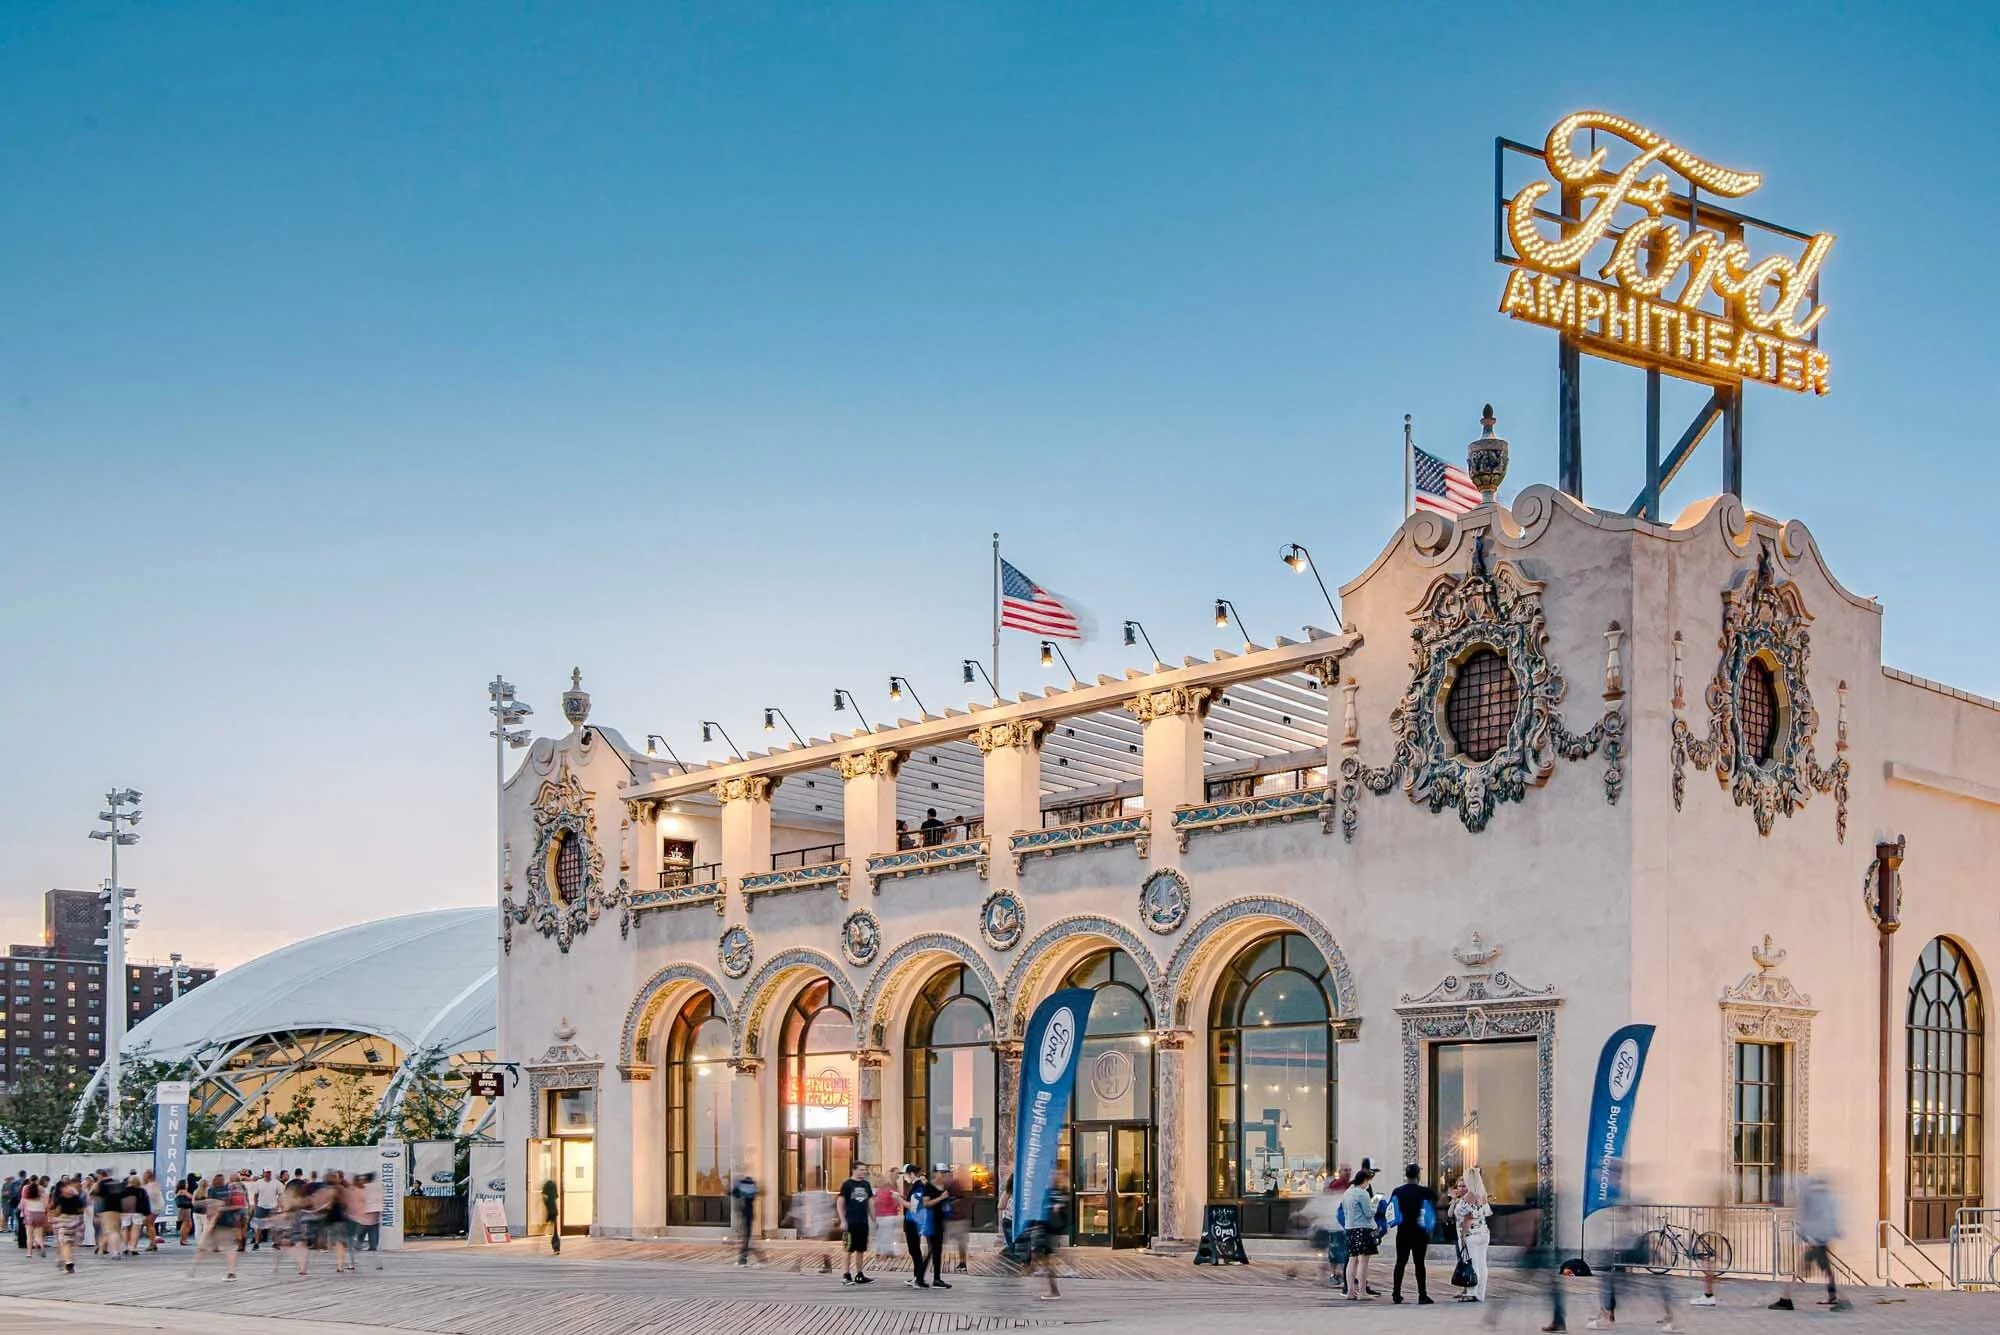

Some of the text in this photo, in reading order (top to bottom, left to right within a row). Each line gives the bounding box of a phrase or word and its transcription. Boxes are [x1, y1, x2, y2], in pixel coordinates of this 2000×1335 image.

[1508, 111, 1836, 338] Ford
[1499, 268, 1832, 397] AMPHITHEATER
[1045, 1022, 1070, 1069] Ford
[1613, 1050, 1634, 1089] Ford
[164, 1104, 180, 1217] ENTRANCE
[382, 1163, 394, 1227] AMPHITHEATER
